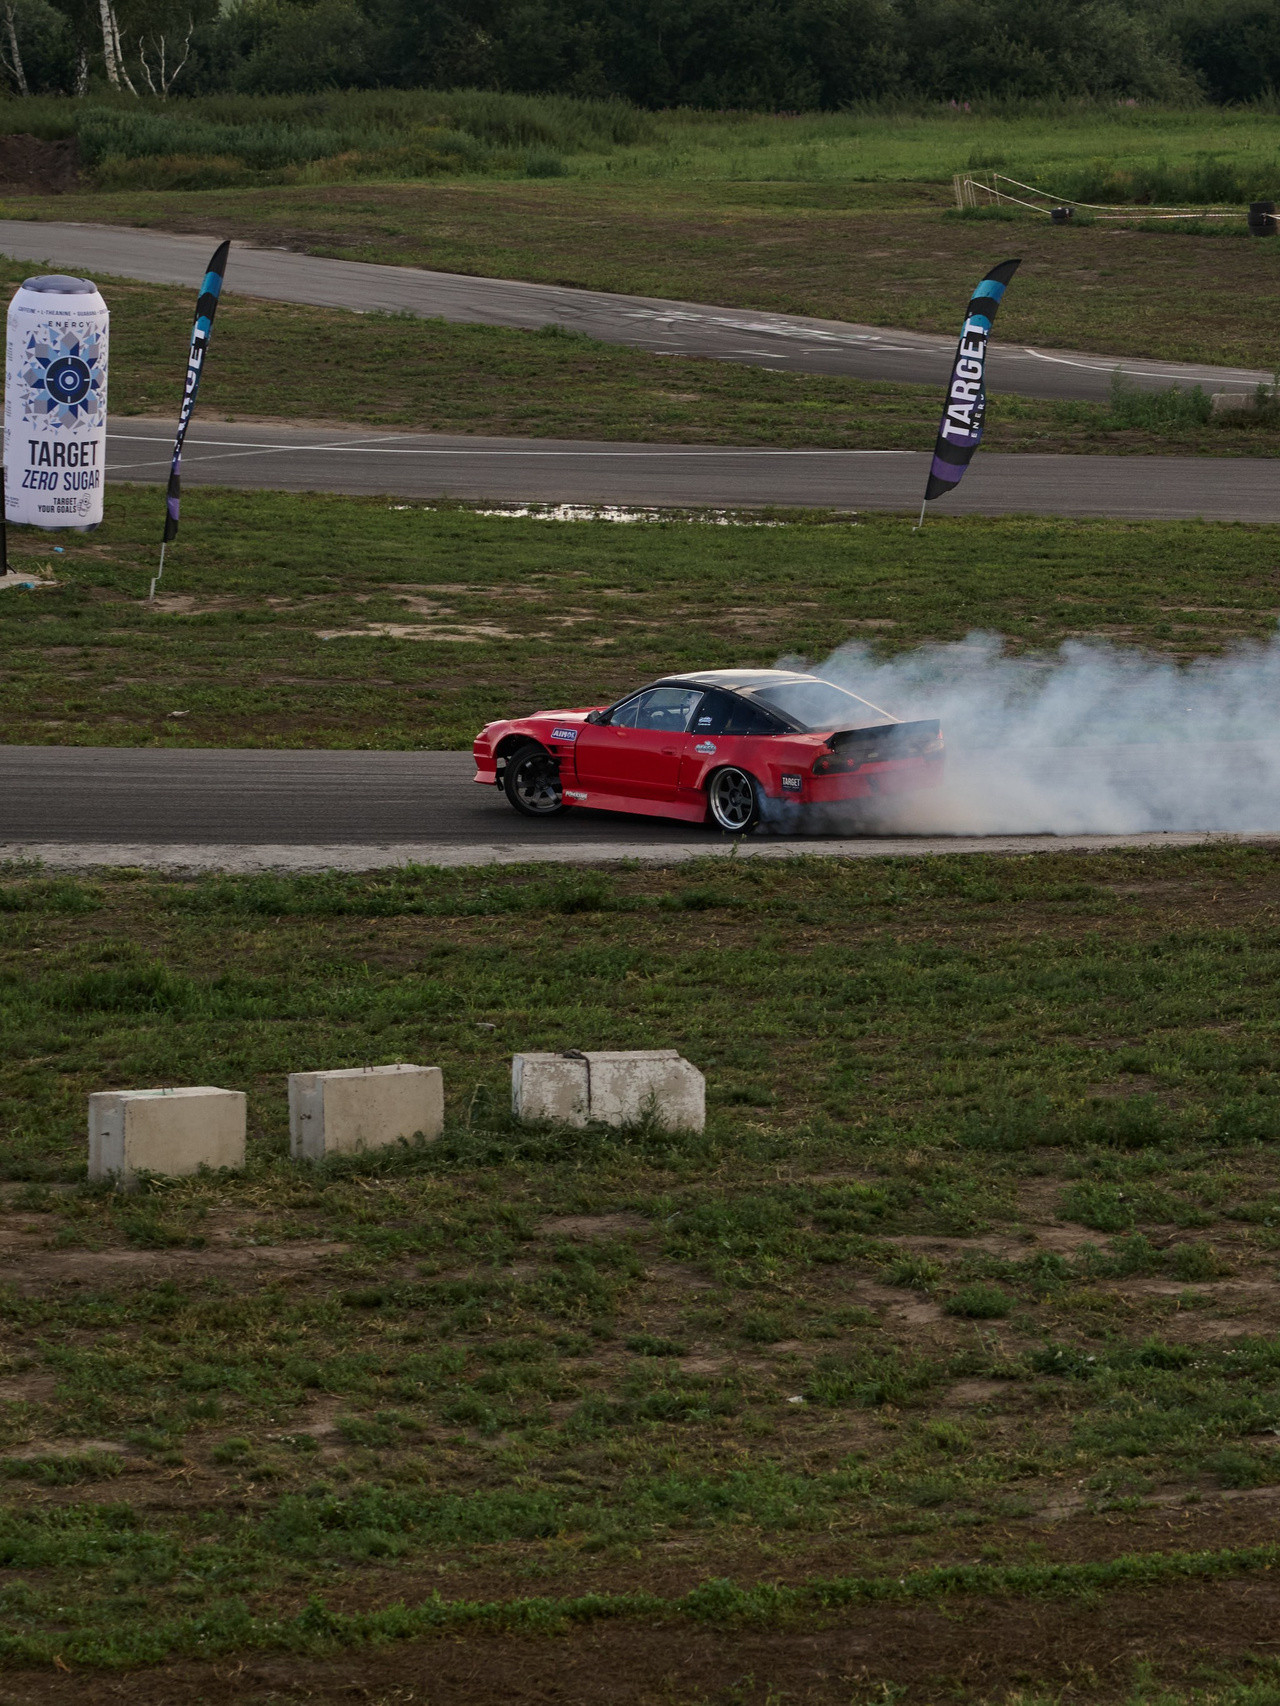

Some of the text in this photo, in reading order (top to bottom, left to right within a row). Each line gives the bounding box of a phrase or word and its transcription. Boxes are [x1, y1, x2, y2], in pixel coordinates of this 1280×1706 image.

[48, 320, 90, 328] ENERGY
[942, 317, 985, 439] TARGET
[28, 439, 98, 467] TARGET
[22, 469, 100, 491] ZERO SUGAR
[53, 497, 77, 505] TARGET
[37, 505, 77, 513] YOUR GOALS
[782, 776, 801, 787] TARGET
